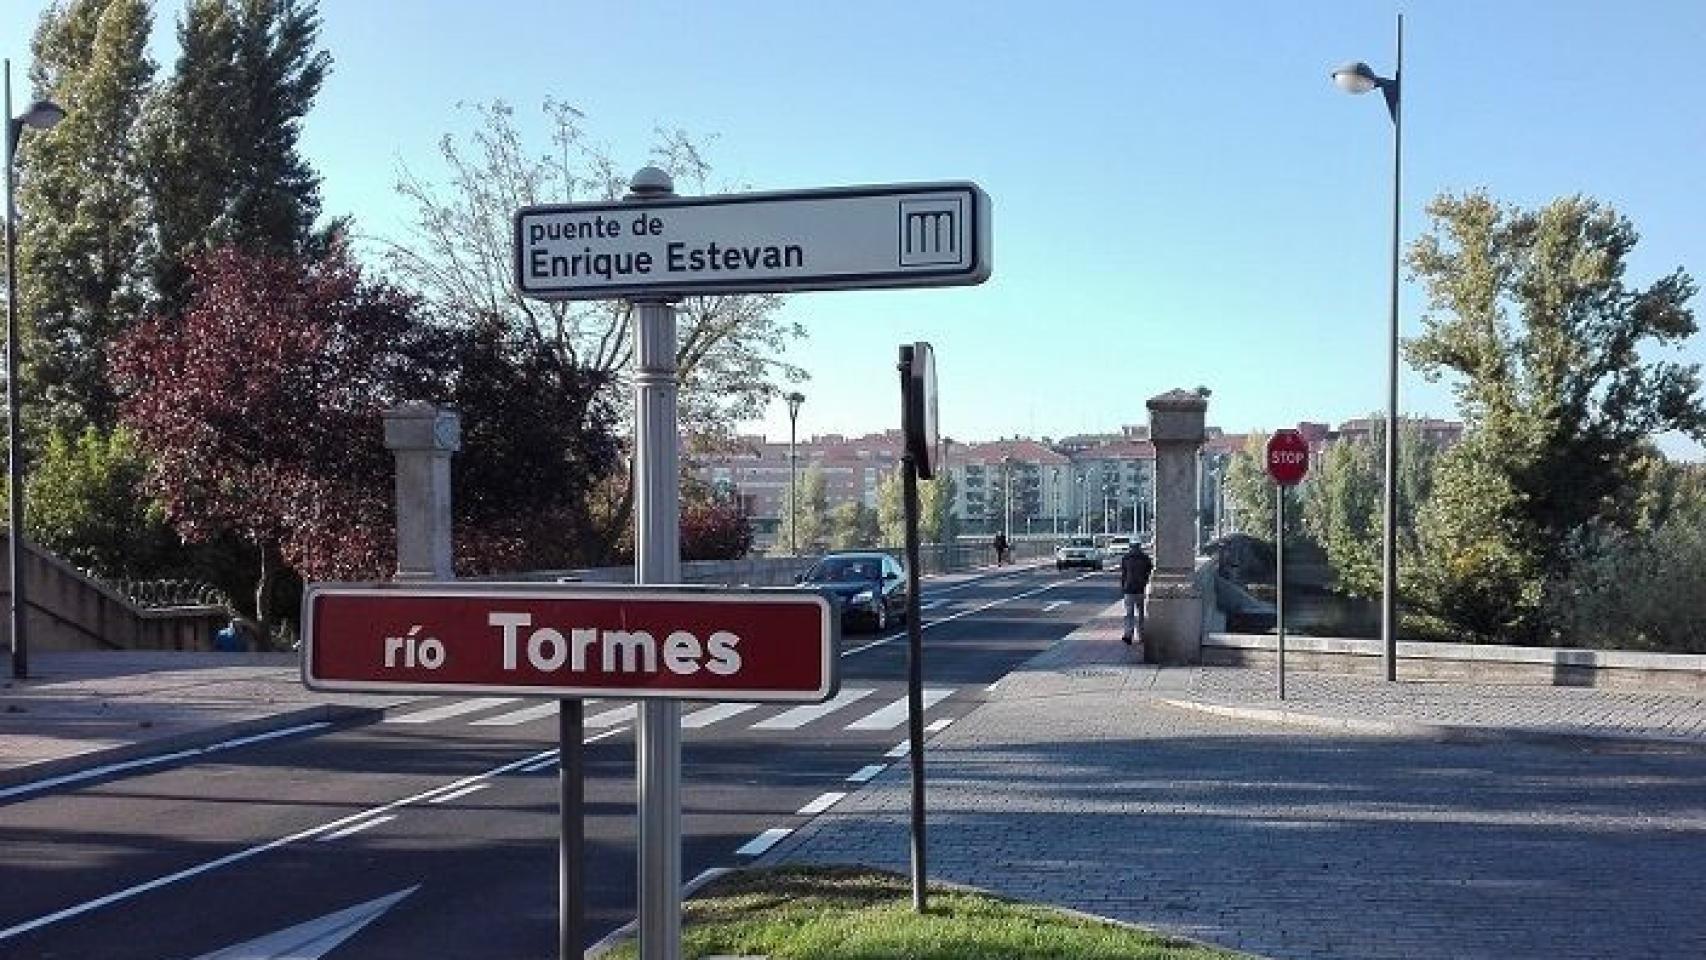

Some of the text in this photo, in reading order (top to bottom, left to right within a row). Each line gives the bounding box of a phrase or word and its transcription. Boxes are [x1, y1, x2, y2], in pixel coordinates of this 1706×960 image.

[530, 213, 664, 243] puente de
[530, 242, 804, 280] Enrique Estevan
[1271, 450, 1305, 464] STOP
[384, 612, 742, 675] río Tormes
